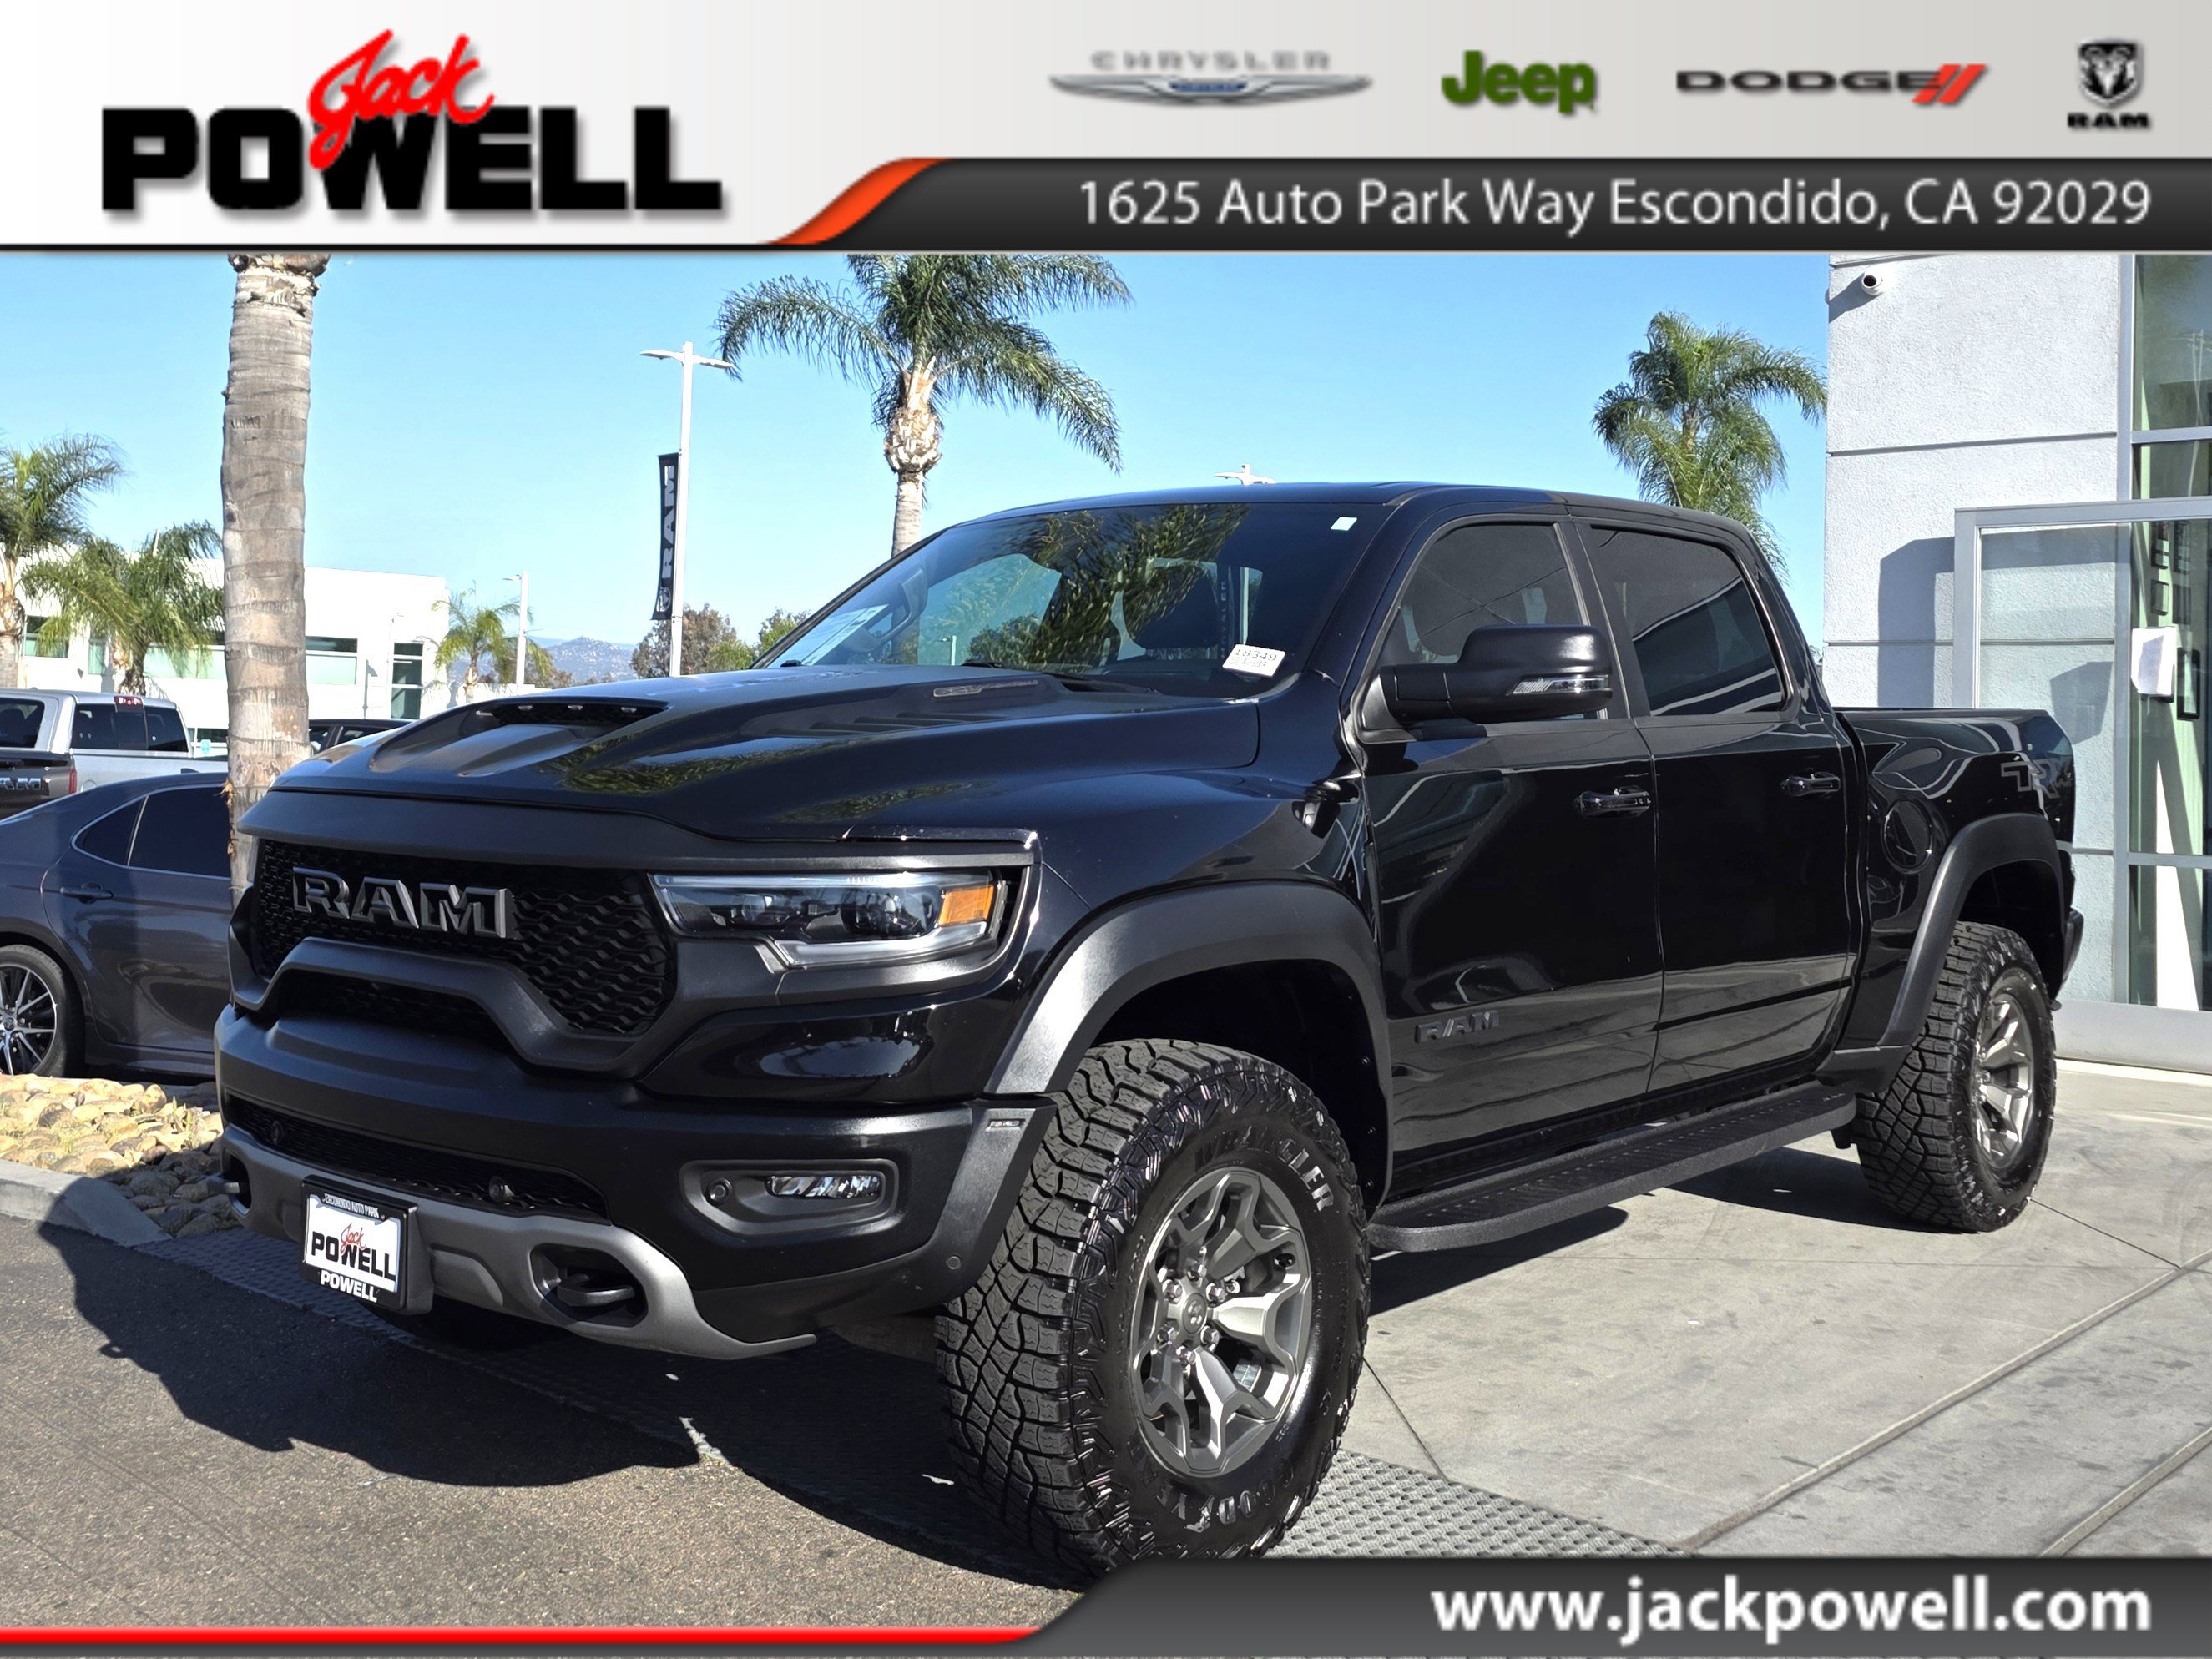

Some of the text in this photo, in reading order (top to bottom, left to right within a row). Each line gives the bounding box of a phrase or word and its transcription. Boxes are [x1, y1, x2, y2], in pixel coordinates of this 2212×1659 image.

[661, 465, 675, 578] RAM
[292, 866, 511, 940] RAM
[1414, 1009, 1500, 1043] RAM
[311, 1230, 396, 1282] POWELL
[341, 1223, 366, 1254] Jack
[320, 1269, 378, 1304] POWELL
